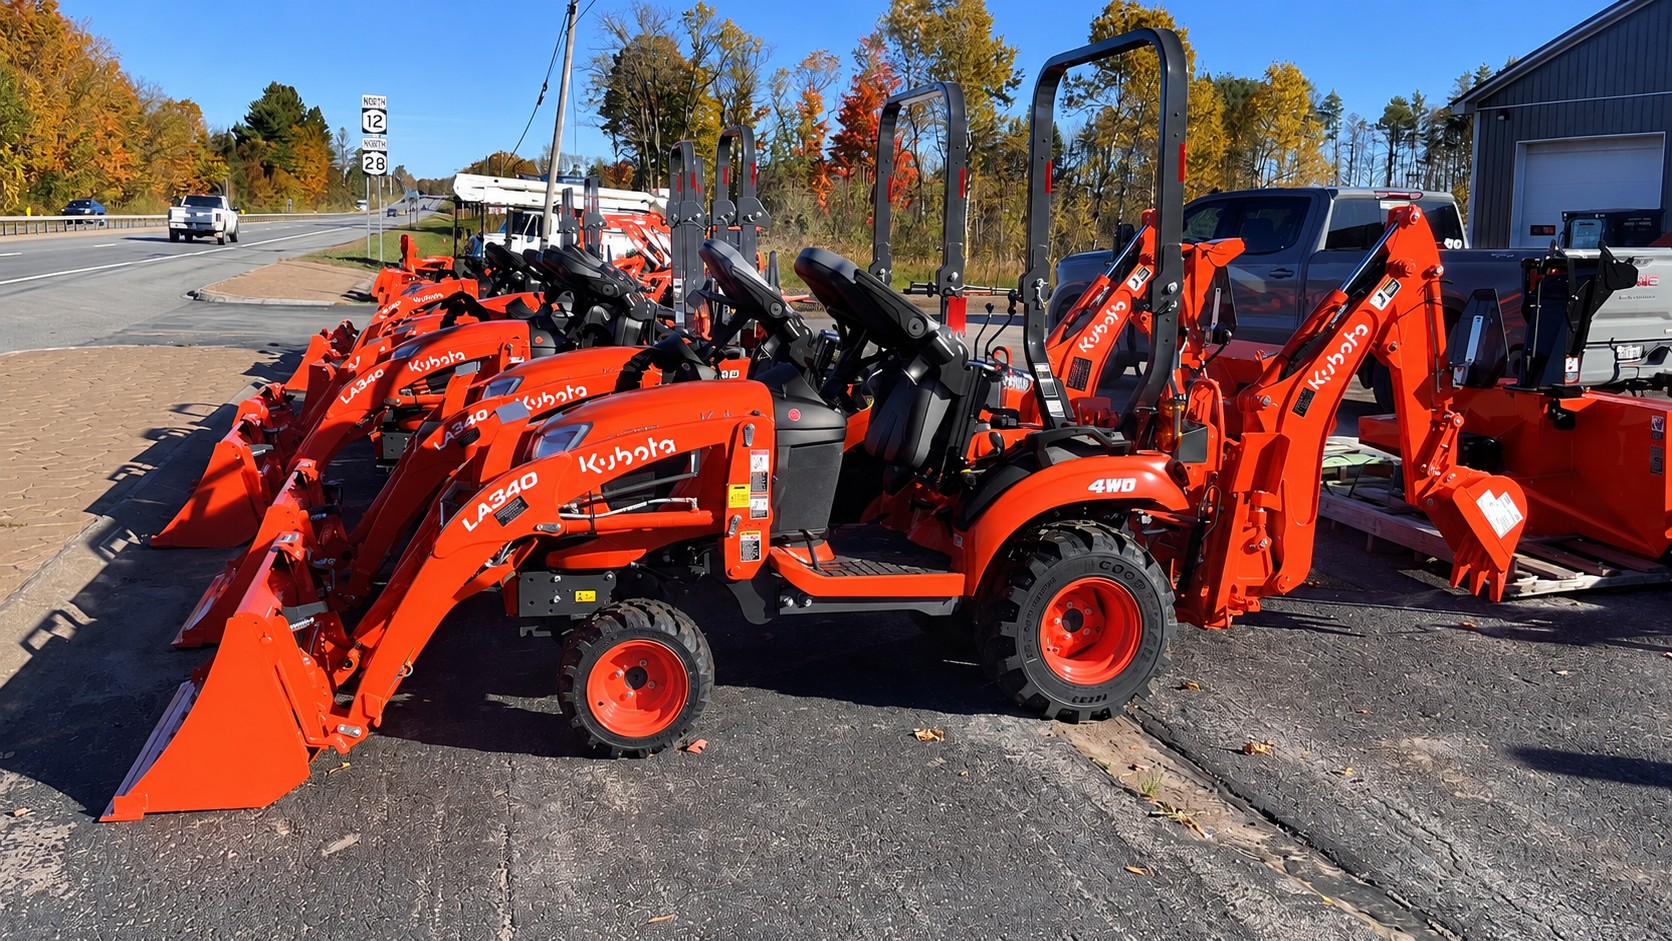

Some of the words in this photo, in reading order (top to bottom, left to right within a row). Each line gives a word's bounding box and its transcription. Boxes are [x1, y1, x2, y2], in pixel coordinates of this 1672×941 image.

[363, 97, 386, 106] NORTH
[367, 114, 383, 129] 12
[365, 156, 385, 171] 28
[1078, 301, 1126, 352] Kubota
[408, 350, 467, 372] Kubota
[1307, 324, 1368, 390] Kubota
[340, 369, 384, 404] LA340
[433, 409, 488, 450] LA340
[579, 437, 676, 473] Kubota
[461, 471, 538, 532] LA340
[1087, 477, 1137, 494] 4WD
